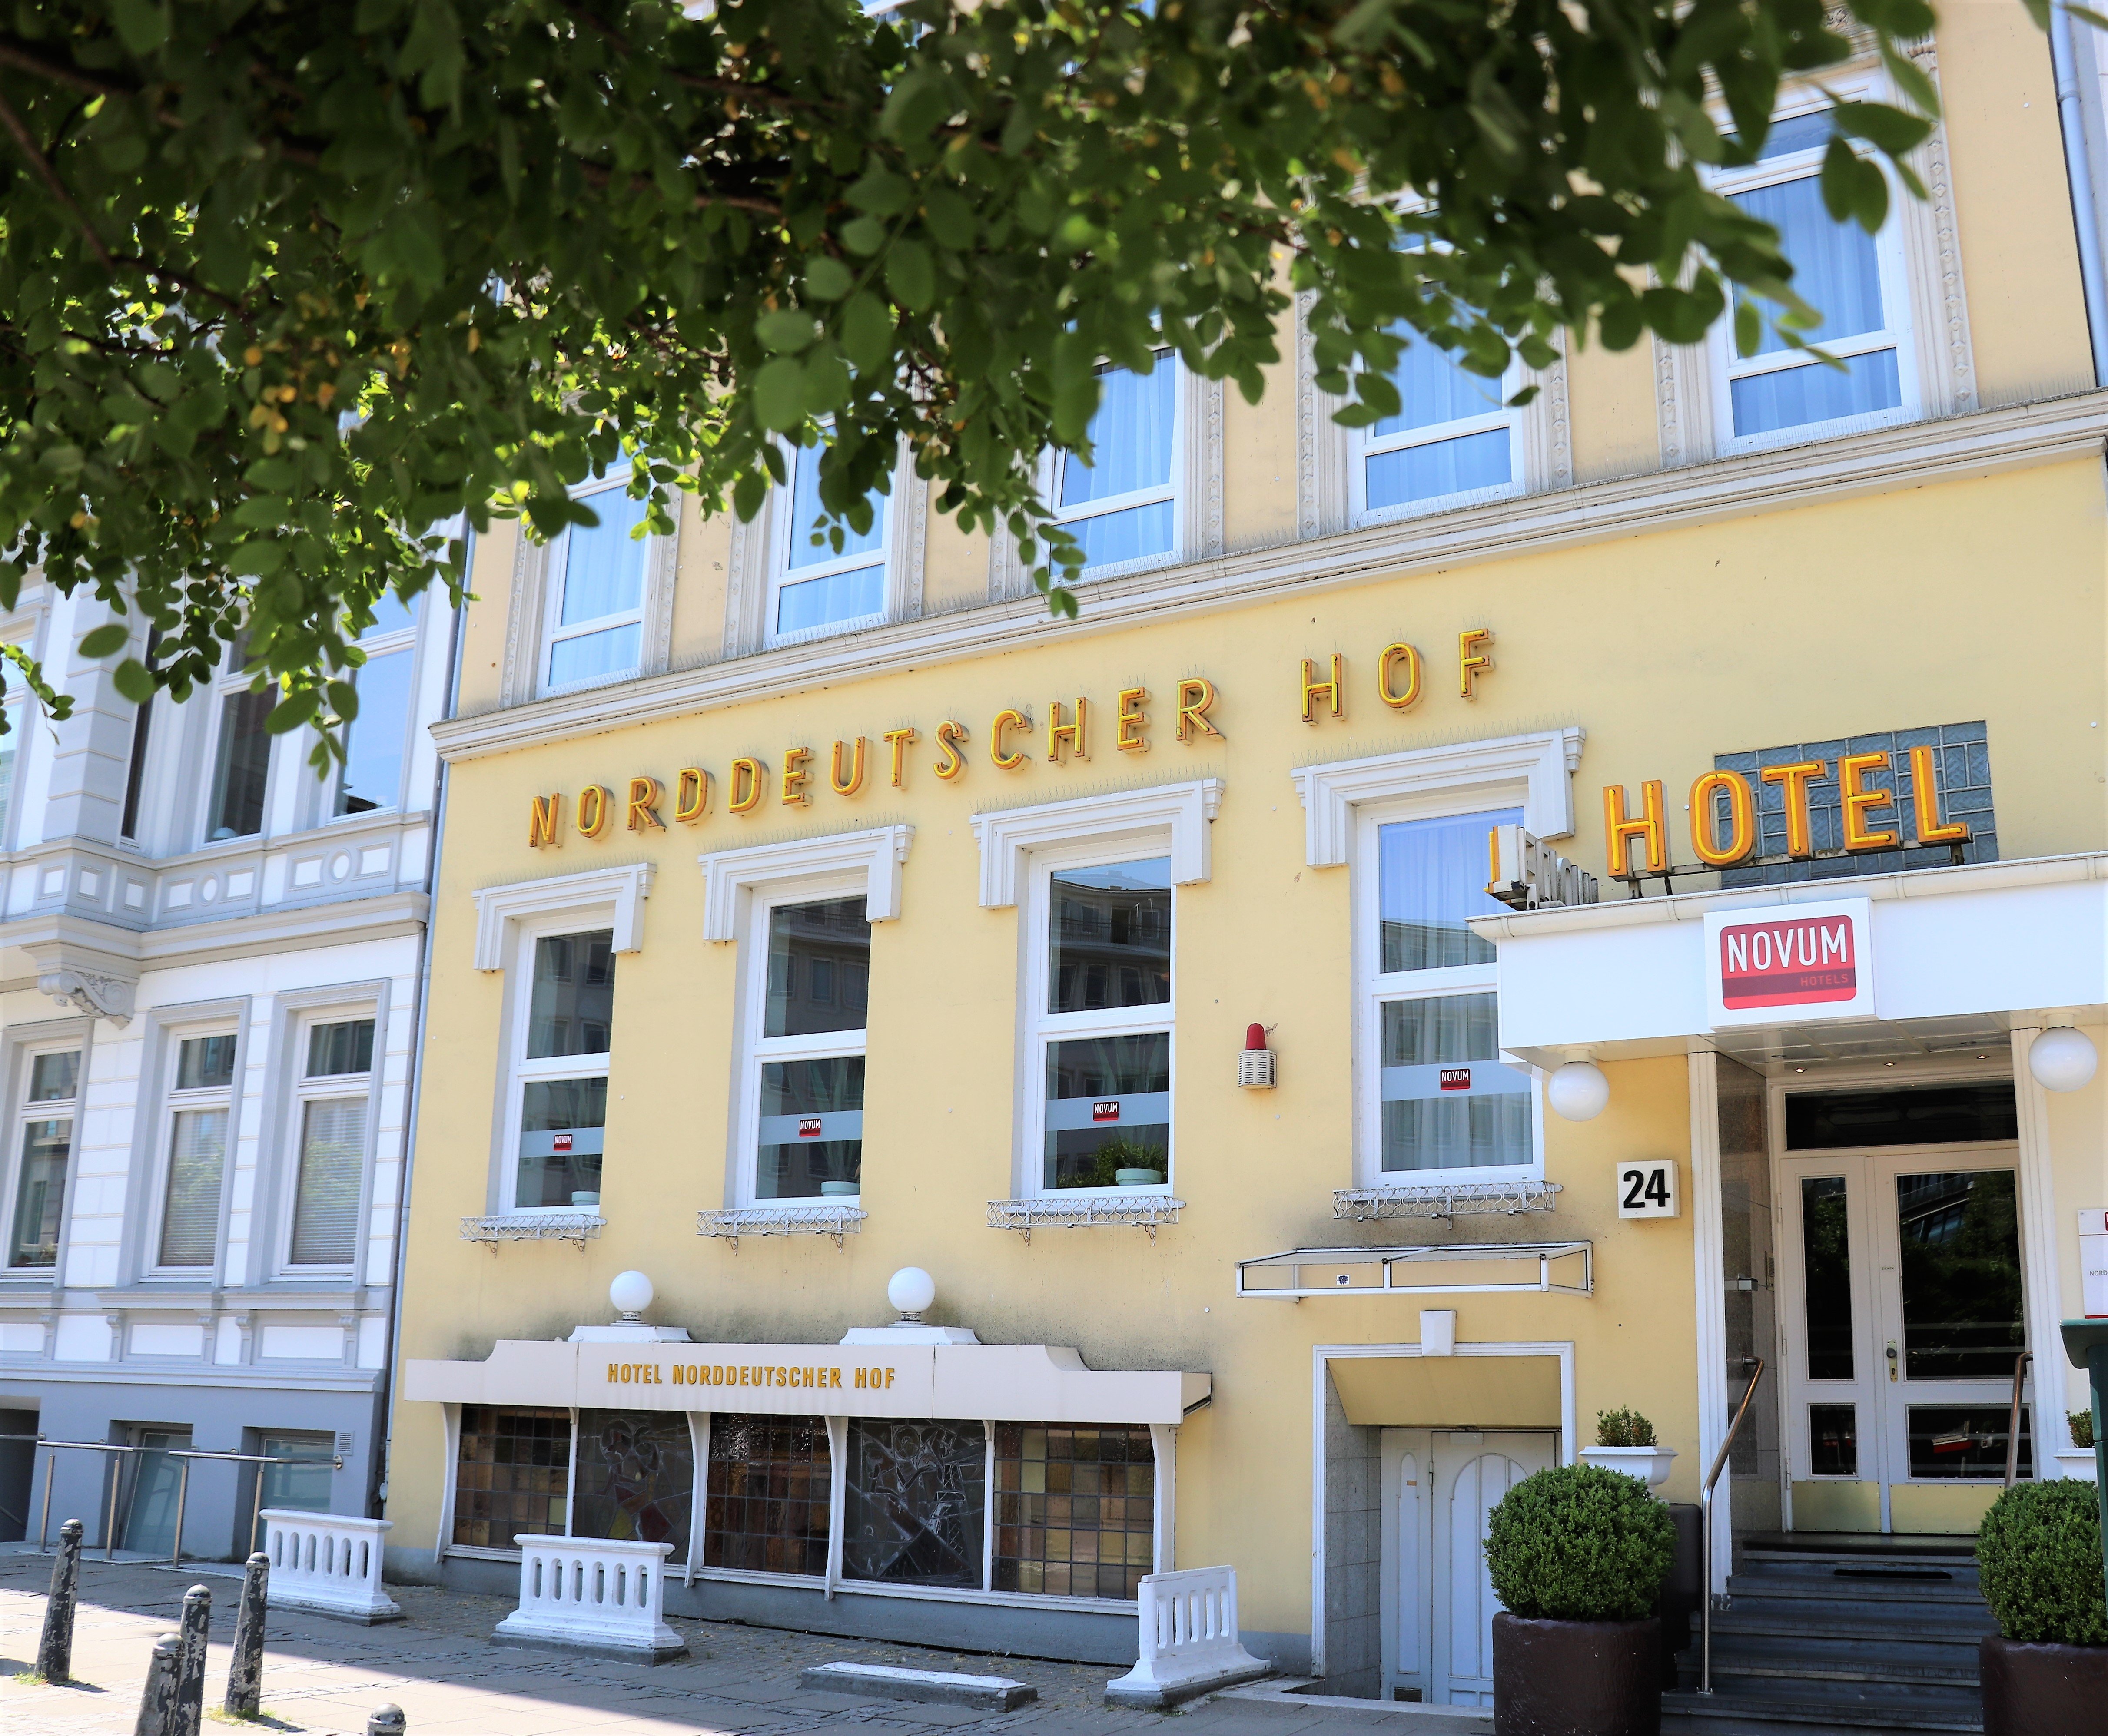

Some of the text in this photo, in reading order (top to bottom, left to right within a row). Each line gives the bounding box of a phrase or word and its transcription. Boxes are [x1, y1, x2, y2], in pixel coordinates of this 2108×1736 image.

[528, 628, 1494, 850] NORDDEUTSCHER HOF
[1602, 744, 1974, 882] HOTEL
[1727, 924, 1847, 973] NOVUM
[1800, 974, 1849, 987] HOTELS
[1441, 1070, 1469, 1082] NOVUM
[1094, 1103, 1118, 1113] NOVUM
[800, 1120, 820, 1130] NOVUM
[554, 1135, 572, 1144] NOVUM
[1623, 1169, 1670, 1208] 24
[608, 1364, 896, 1388] HOTEL NORDDEUTSCHER HOF
